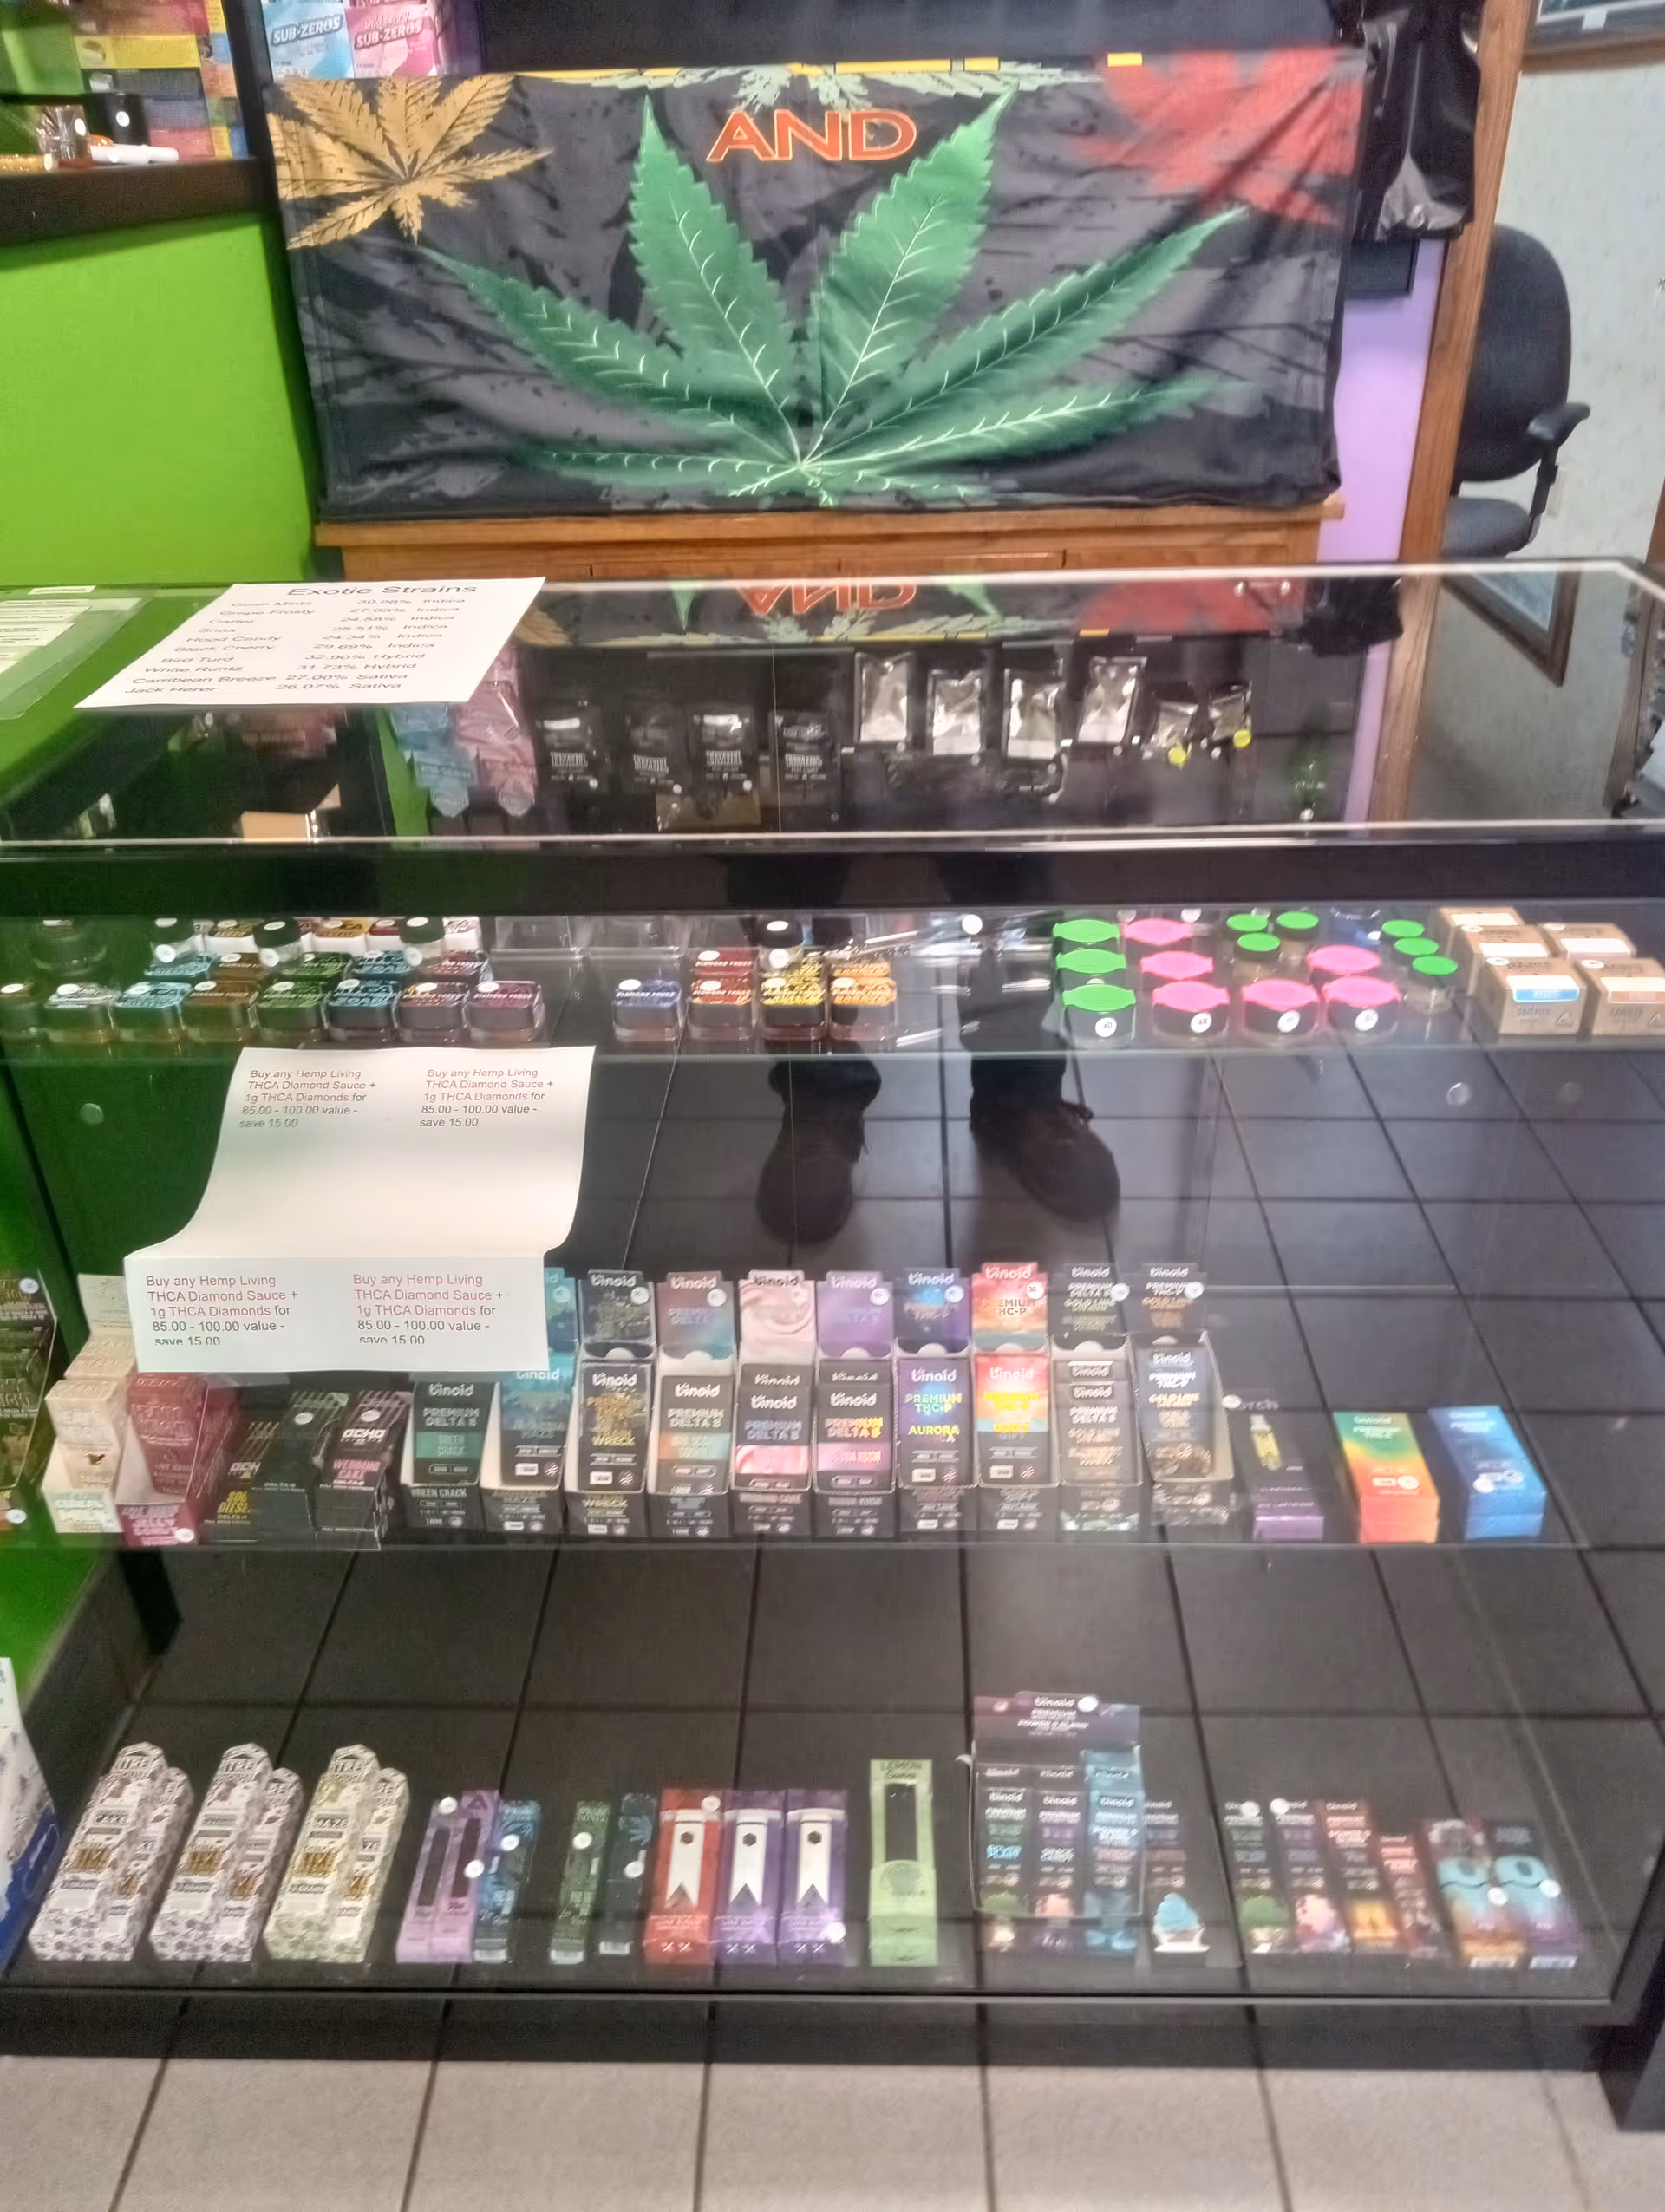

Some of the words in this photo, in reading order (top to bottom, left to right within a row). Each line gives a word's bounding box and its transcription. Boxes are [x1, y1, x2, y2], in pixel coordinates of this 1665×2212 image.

[273, 16, 342, 43] SUB-ZEROS
[356, 19, 423, 49] SUB-ZEROS
[706, 108, 917, 162] AND
[288, 587, 372, 596] Exotic
[250, 1069, 271, 1080] Buy
[273, 1071, 293, 1080] any
[296, 1069, 329, 1080] Hemp
[330, 1069, 362, 1080] Living
[427, 1068, 448, 1079] Buy
[473, 1068, 505, 1079] Hemp
[506, 1068, 539, 1079] Living
[248, 1080, 280, 1090] THCA
[283, 1080, 330, 1090] Diamond
[332, 1080, 366, 1090] Sauce
[425, 1080, 457, 1089] THCA
[460, 1080, 507, 1089] Diamond
[510, 1080, 544, 1089] Sauce
[245, 1093, 258, 1104] 1g
[261, 1093, 293, 1102] THCA
[296, 1093, 349, 1102] Diamonds
[351, 1093, 367, 1102] for
[424, 1093, 437, 1103] 1g
[440, 1092, 472, 1101] THCA
[474, 1092, 527, 1101] Diamonds
[530, 1092, 545, 1101] for
[284, 1105, 320, 1115] 100.00
[322, 1105, 350, 1115] value
[421, 1105, 451, 1114] 85.00
[462, 1104, 499, 1114] 100.00
[501, 1104, 530, 1114] value
[268, 1118, 299, 1128] 15.00
[419, 1119, 445, 1128] save
[448, 1118, 479, 1127] 15.00
[147, 1275, 169, 1289] Buy
[173, 1278, 196, 1289] any
[199, 1275, 236, 1289] Hemp
[240, 1275, 277, 1289] Living
[353, 1274, 376, 1287] Buy
[380, 1276, 402, 1288] any
[407, 1274, 443, 1288] Hemp
[447, 1274, 483, 1288] Living
[147, 1290, 186, 1302] THCA
[188, 1289, 243, 1302] Diamond
[246, 1289, 287, 1302] Sauce
[354, 1289, 392, 1301] THCA
[395, 1288, 450, 1301] Diamond
[453, 1289, 492, 1301] Sauce
[151, 1306, 166, 1319] 1g
[168, 1305, 206, 1316] THCA
[209, 1304, 271, 1316] Diamonds
[274, 1304, 291, 1315] for
[356, 1305, 372, 1318] 1g
[375, 1304, 412, 1315] THCA
[415, 1303, 476, 1315] Diamonds
[480, 1303, 496, 1315] for
[152, 1321, 186, 1332] 85.00
[199, 1320, 240, 1332] 100.00
[243, 1320, 277, 1331] value
[357, 1320, 392, 1331] 85.00
[404, 1320, 445, 1331] 100.00
[447, 1319, 482, 1331] value
[187, 1336, 220, 1346] 1500
[392, 1334, 425, 1344] 1500
[905, 1393, 962, 1404] PREMIUM
[423, 1408, 480, 1418] PREMIUM
[915, 1403, 952, 1413] THC-P
[425, 1417, 460, 1427] DELTA
[908, 1425, 961, 1435] AURORA
